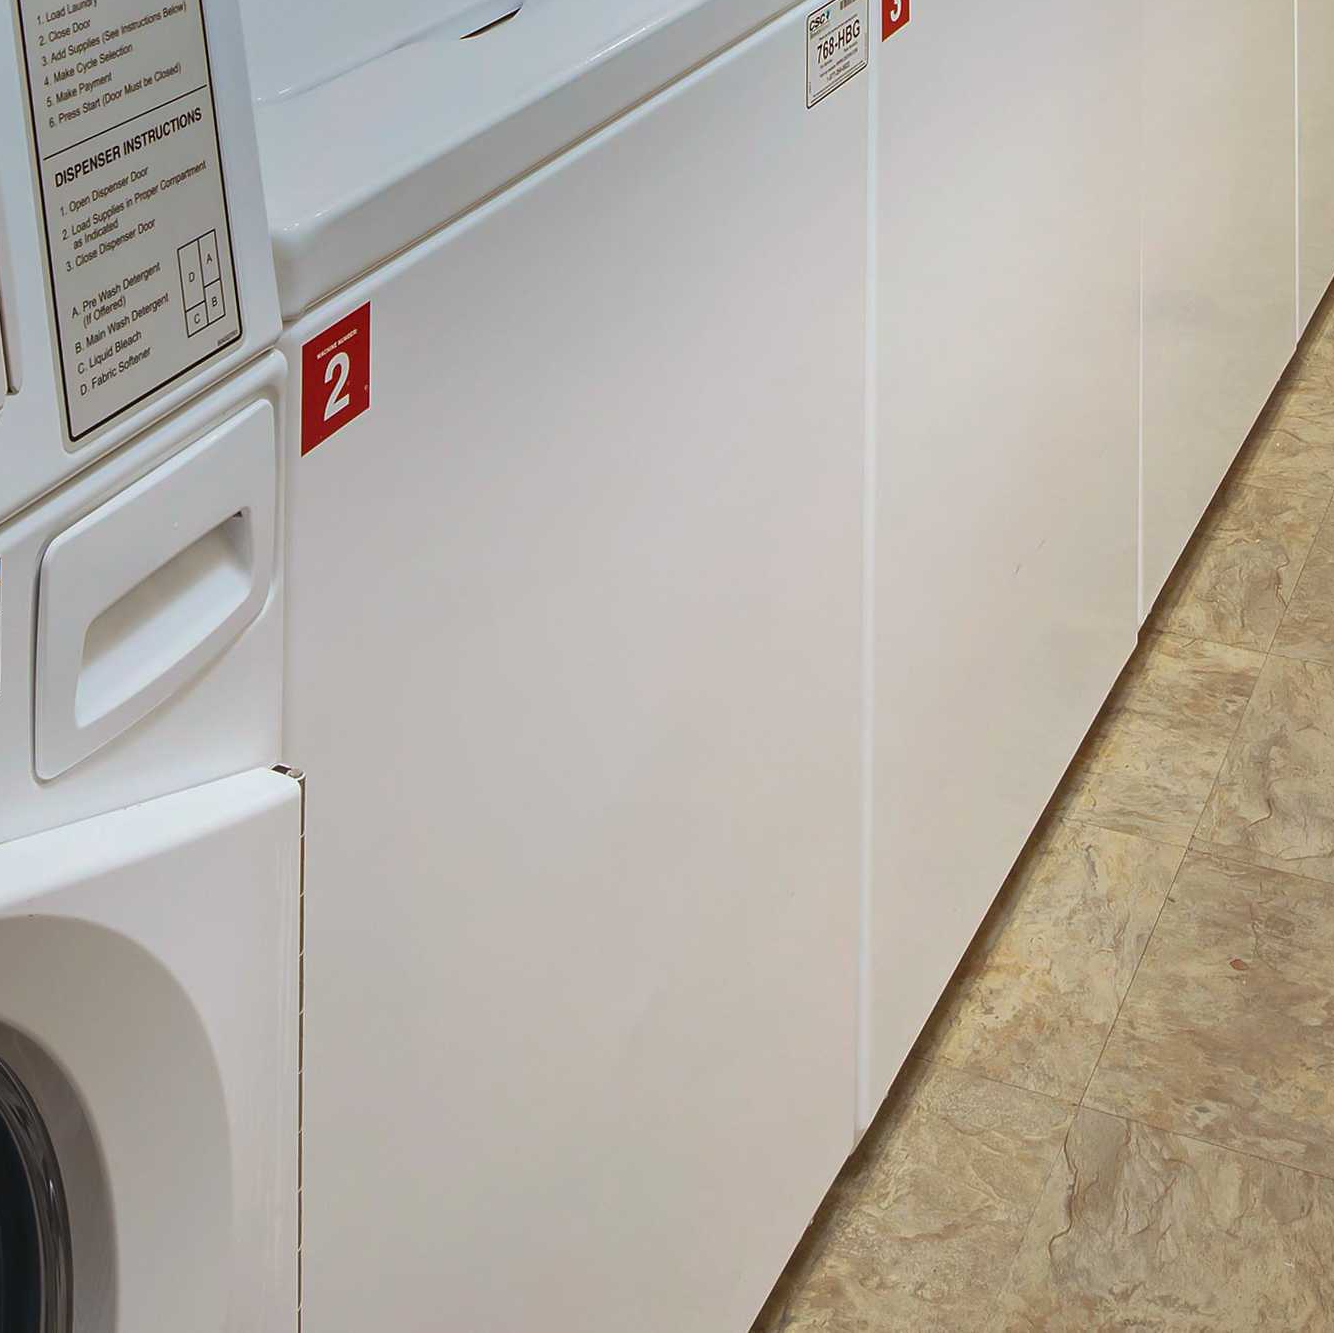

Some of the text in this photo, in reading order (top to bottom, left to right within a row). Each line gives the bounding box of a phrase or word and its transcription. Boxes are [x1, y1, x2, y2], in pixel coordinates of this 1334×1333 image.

[37, 15, 44, 26] 1.
[46, 7, 66, 23] Load
[38, 19, 91, 47] 2. Close Door
[41, 0, 187, 67] 3. Add Supplies (See Instructions Below)
[817, 19, 860, 64] 768-HBG
[44, 44, 133, 87] 4. Make Cycle Selection
[46, 72, 113, 107] 5. Make Payment
[48, 62, 181, 128] 6. Press Start (Door Must be Closed)
[54, 107, 202, 188] DISPENSER INSTRUCTIONS
[60, 166, 149, 217] 1. Open Dispenser Door
[62, 159, 207, 241] 2. Load Supplies in Proper Compartment
[66, 218, 156, 272] 3. Close Dispenser Door
[73, 218, 118, 250] as Indicated
[188, 271, 195, 283] D
[206, 253, 213, 264] A
[72, 262, 161, 319] A. Pre Wash Detergent
[83, 295, 127, 329] (If Offered)
[211, 296, 218, 307] B
[75, 293, 169, 354] B. Main Wash Detergent
[194, 313, 201, 324] C
[78, 330, 142, 374] C. Liquid Bleach
[80, 347, 152, 396] D. Fabric Softener
[324, 352, 350, 422] 2
